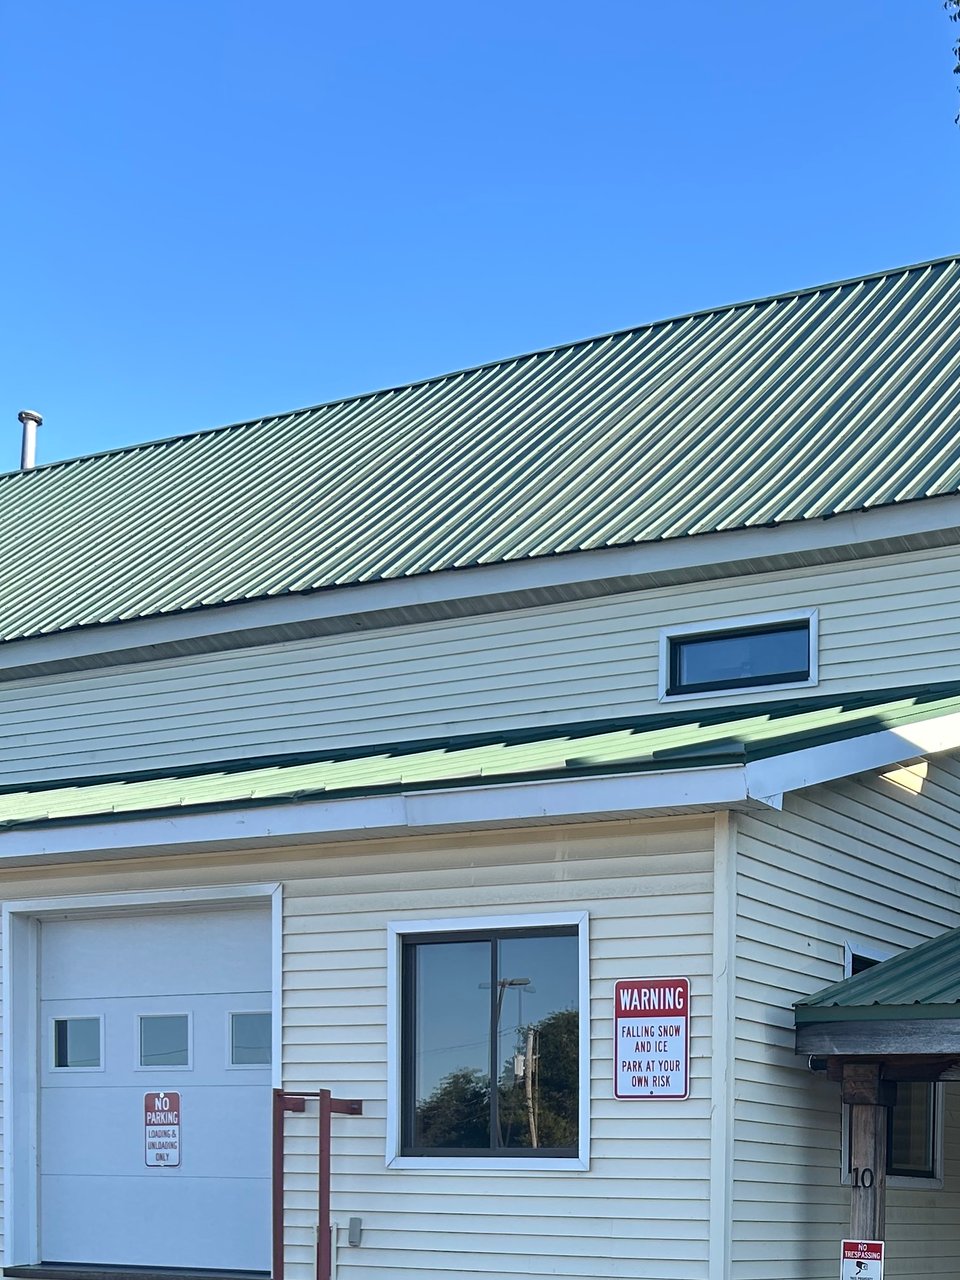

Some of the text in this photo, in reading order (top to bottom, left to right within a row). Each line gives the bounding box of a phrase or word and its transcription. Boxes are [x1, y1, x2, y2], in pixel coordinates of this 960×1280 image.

[620, 987, 684, 1010] WARNING
[622, 1025, 681, 1037] FALLING SNOW
[635, 1041, 668, 1052] AND ICE
[622, 1060, 681, 1072] PARK AT YOUR
[632, 1075, 671, 1087] OWN RISK
[155, 1097, 170, 1110] NO
[147, 1111, 178, 1124] PARKING
[148, 1130, 176, 1138] LOADING &
[148, 1141, 177, 1149] UNLOADING
[155, 1153, 169, 1161] ONLY
[852, 1168, 874, 1188] 10
[845, 1251, 880, 1259] TRESPASSING
